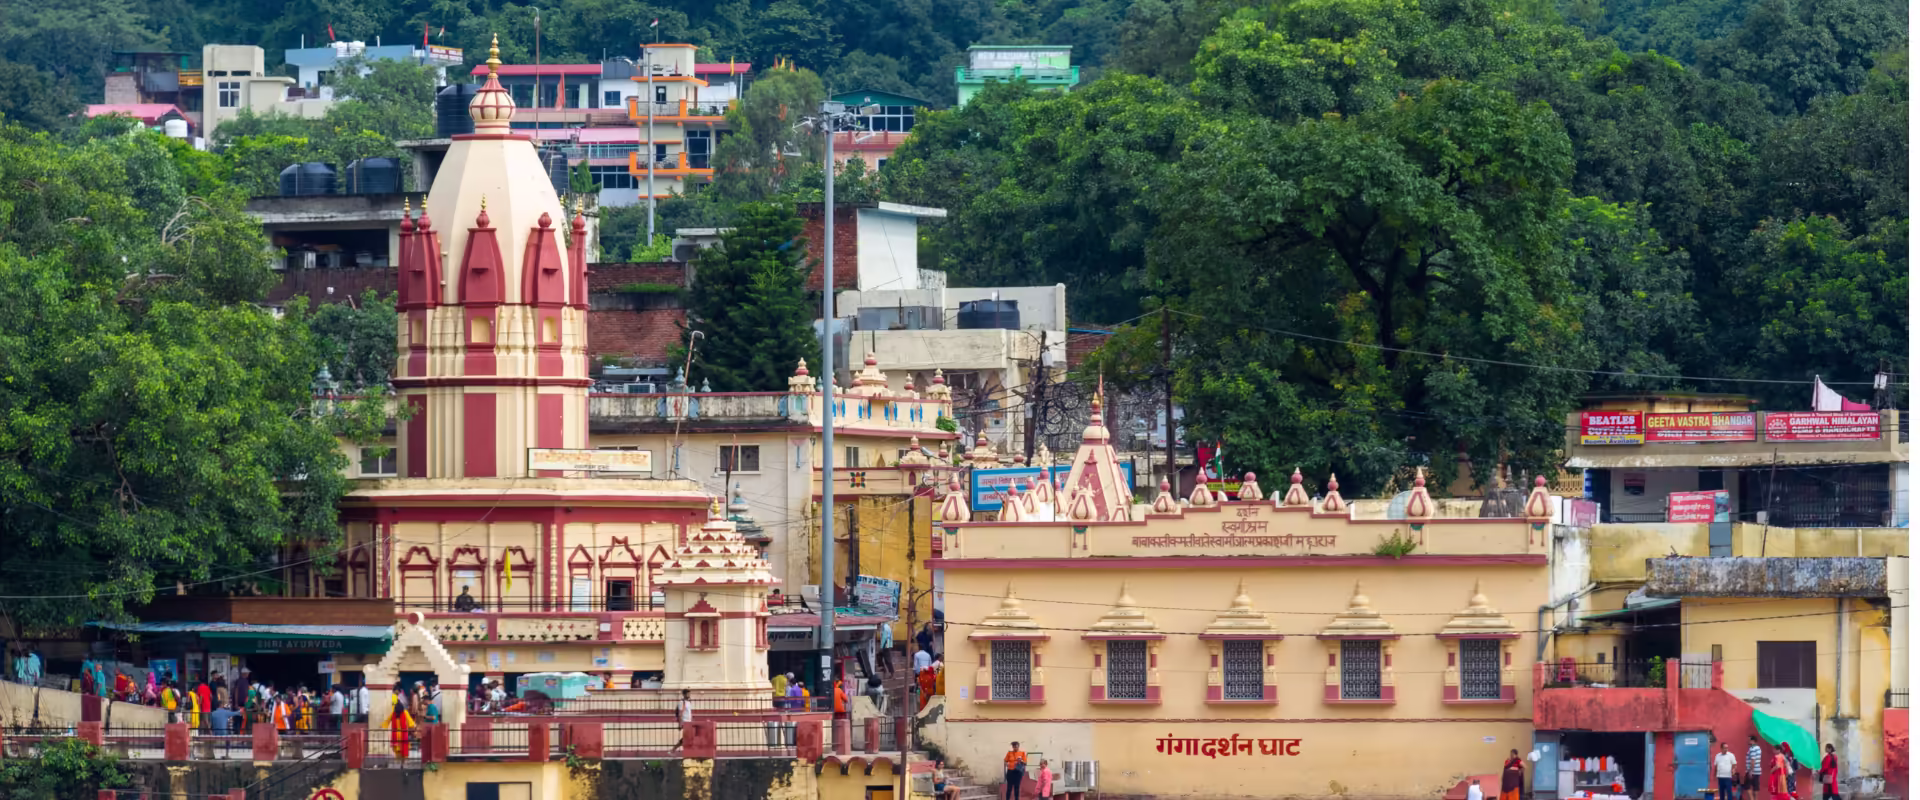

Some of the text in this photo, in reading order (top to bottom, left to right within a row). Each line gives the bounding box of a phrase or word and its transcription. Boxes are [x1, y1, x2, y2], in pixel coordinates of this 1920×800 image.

[1589, 415, 1635, 425] BEATLES
[1648, 415, 1753, 427] GEETA VASTRA BHANDAR
[1789, 417, 1878, 425] GARHWAL HIMALAYAN
[1236, 504, 1260, 517] दर्शन
[257, 640, 342, 648] SHRI AYURVEDA
[1156, 733, 1302, 759] गंगा दर्शन घाट
